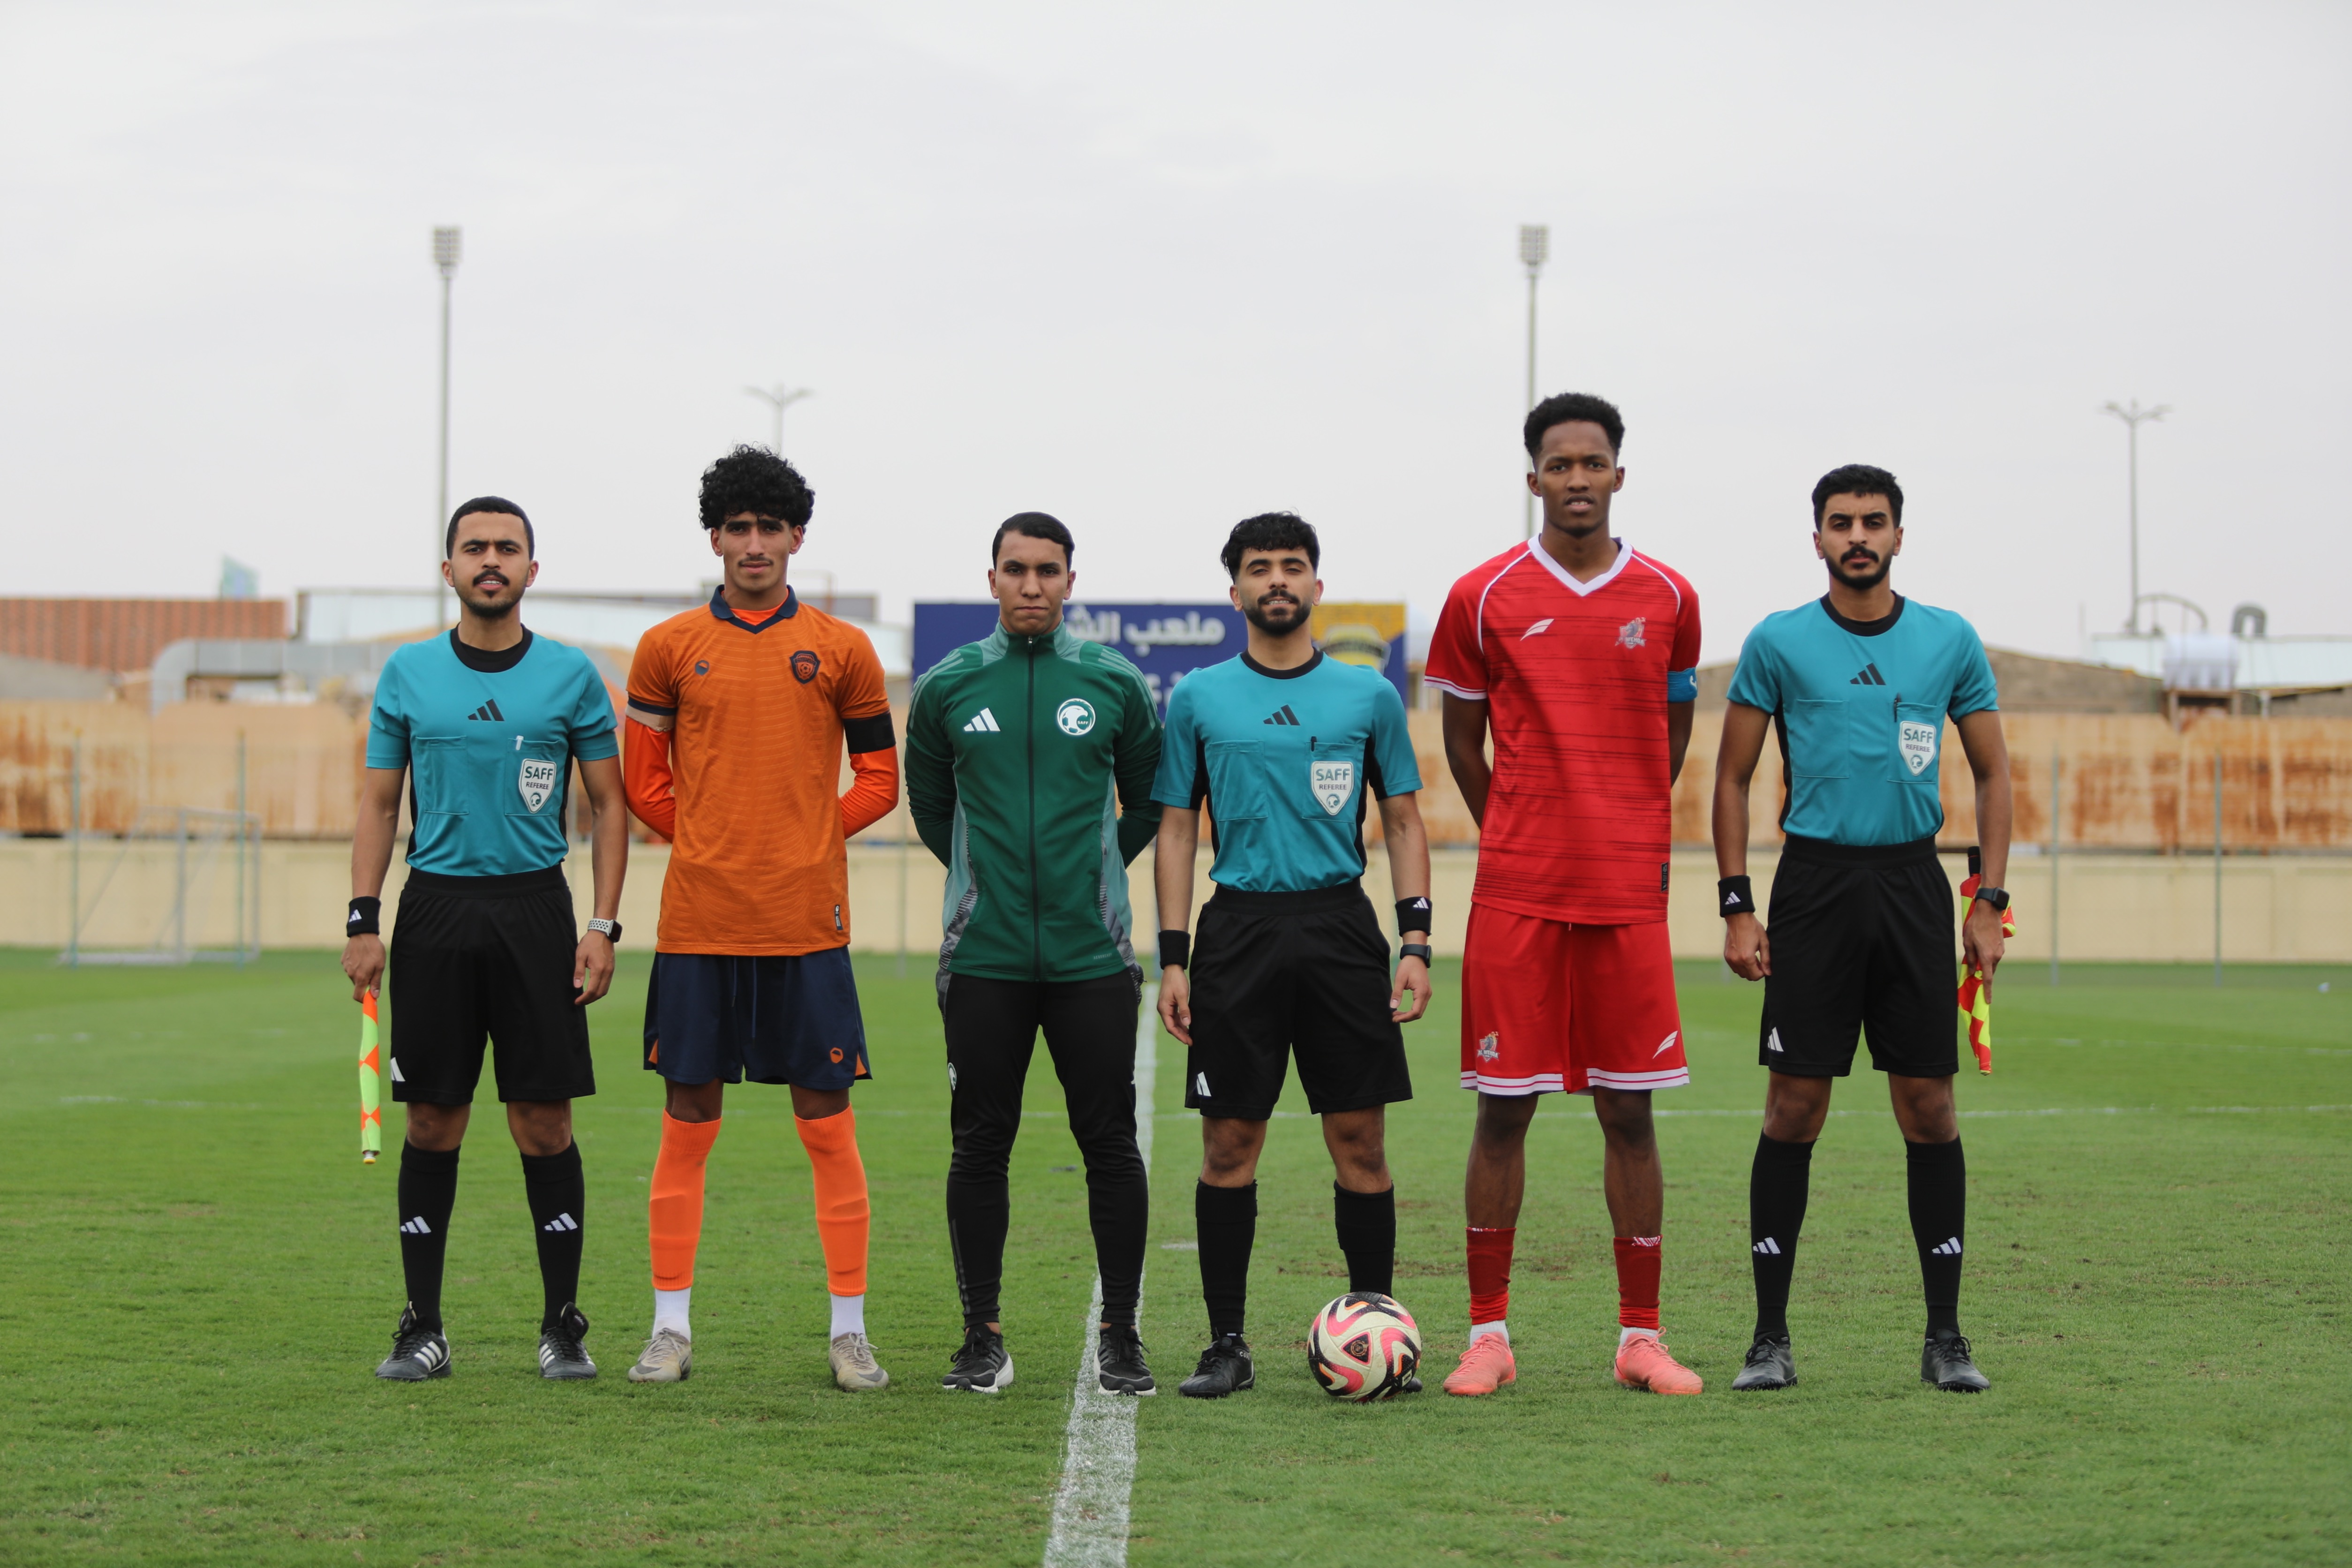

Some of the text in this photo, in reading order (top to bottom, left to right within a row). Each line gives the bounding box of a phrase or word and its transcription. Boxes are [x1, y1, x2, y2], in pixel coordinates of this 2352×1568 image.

[1124, 611, 1226, 657] ملعب
[1904, 728, 1933, 743] SAFF
[1906, 744, 1930, 752] REFEREE
[525, 766, 554, 780] SAFF
[1316, 769, 1350, 781] SAFF
[526, 782, 550, 790] REFEREE
